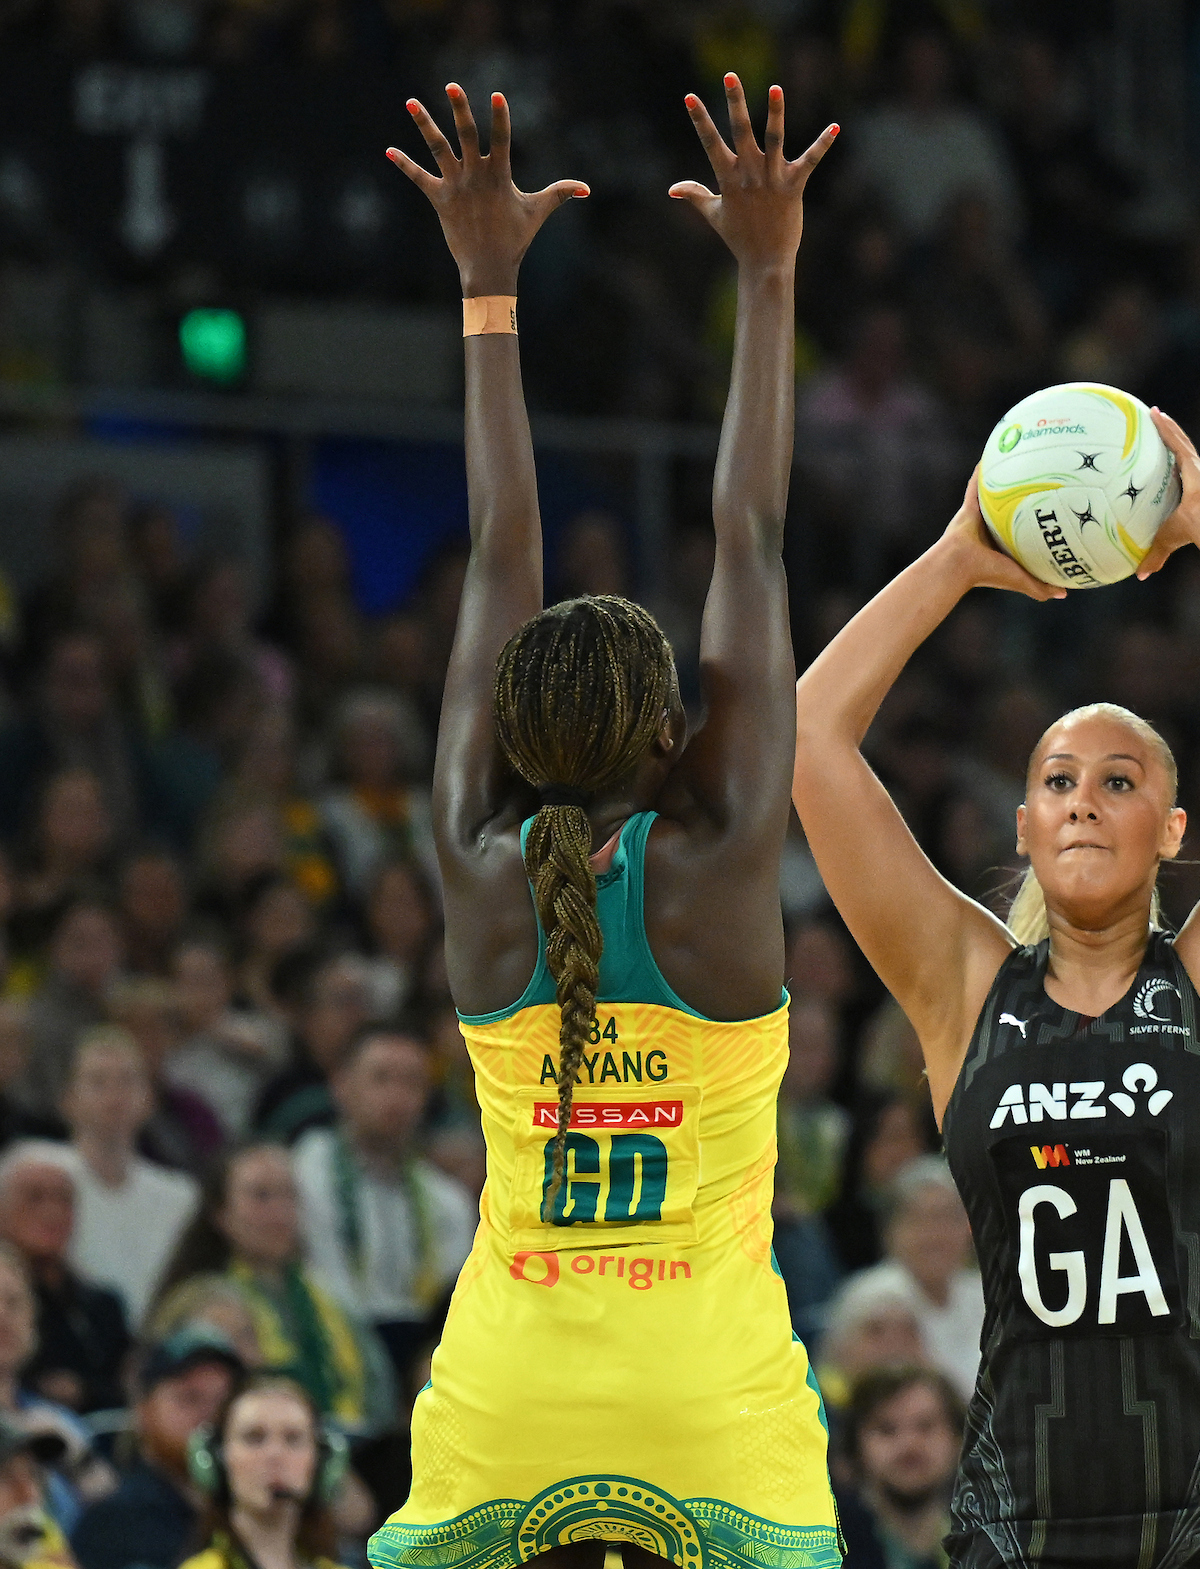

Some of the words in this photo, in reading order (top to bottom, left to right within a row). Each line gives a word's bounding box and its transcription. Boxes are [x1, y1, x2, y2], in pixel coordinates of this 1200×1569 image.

[1022, 423, 1086, 441] diamonds
[1129, 1024, 1159, 1035] SILVER
[1161, 1024, 1190, 1036] FERNS
[989, 1081, 1107, 1129] ANZ
[540, 1106, 676, 1124] NSSAN
[1074, 1149, 1091, 1157] WM
[1075, 1158, 1093, 1166] New
[1094, 1155, 1126, 1164] Zealand
[540, 1132, 668, 1226] GD
[1018, 1179, 1171, 1327] GA
[570, 1254, 692, 1291] origin
